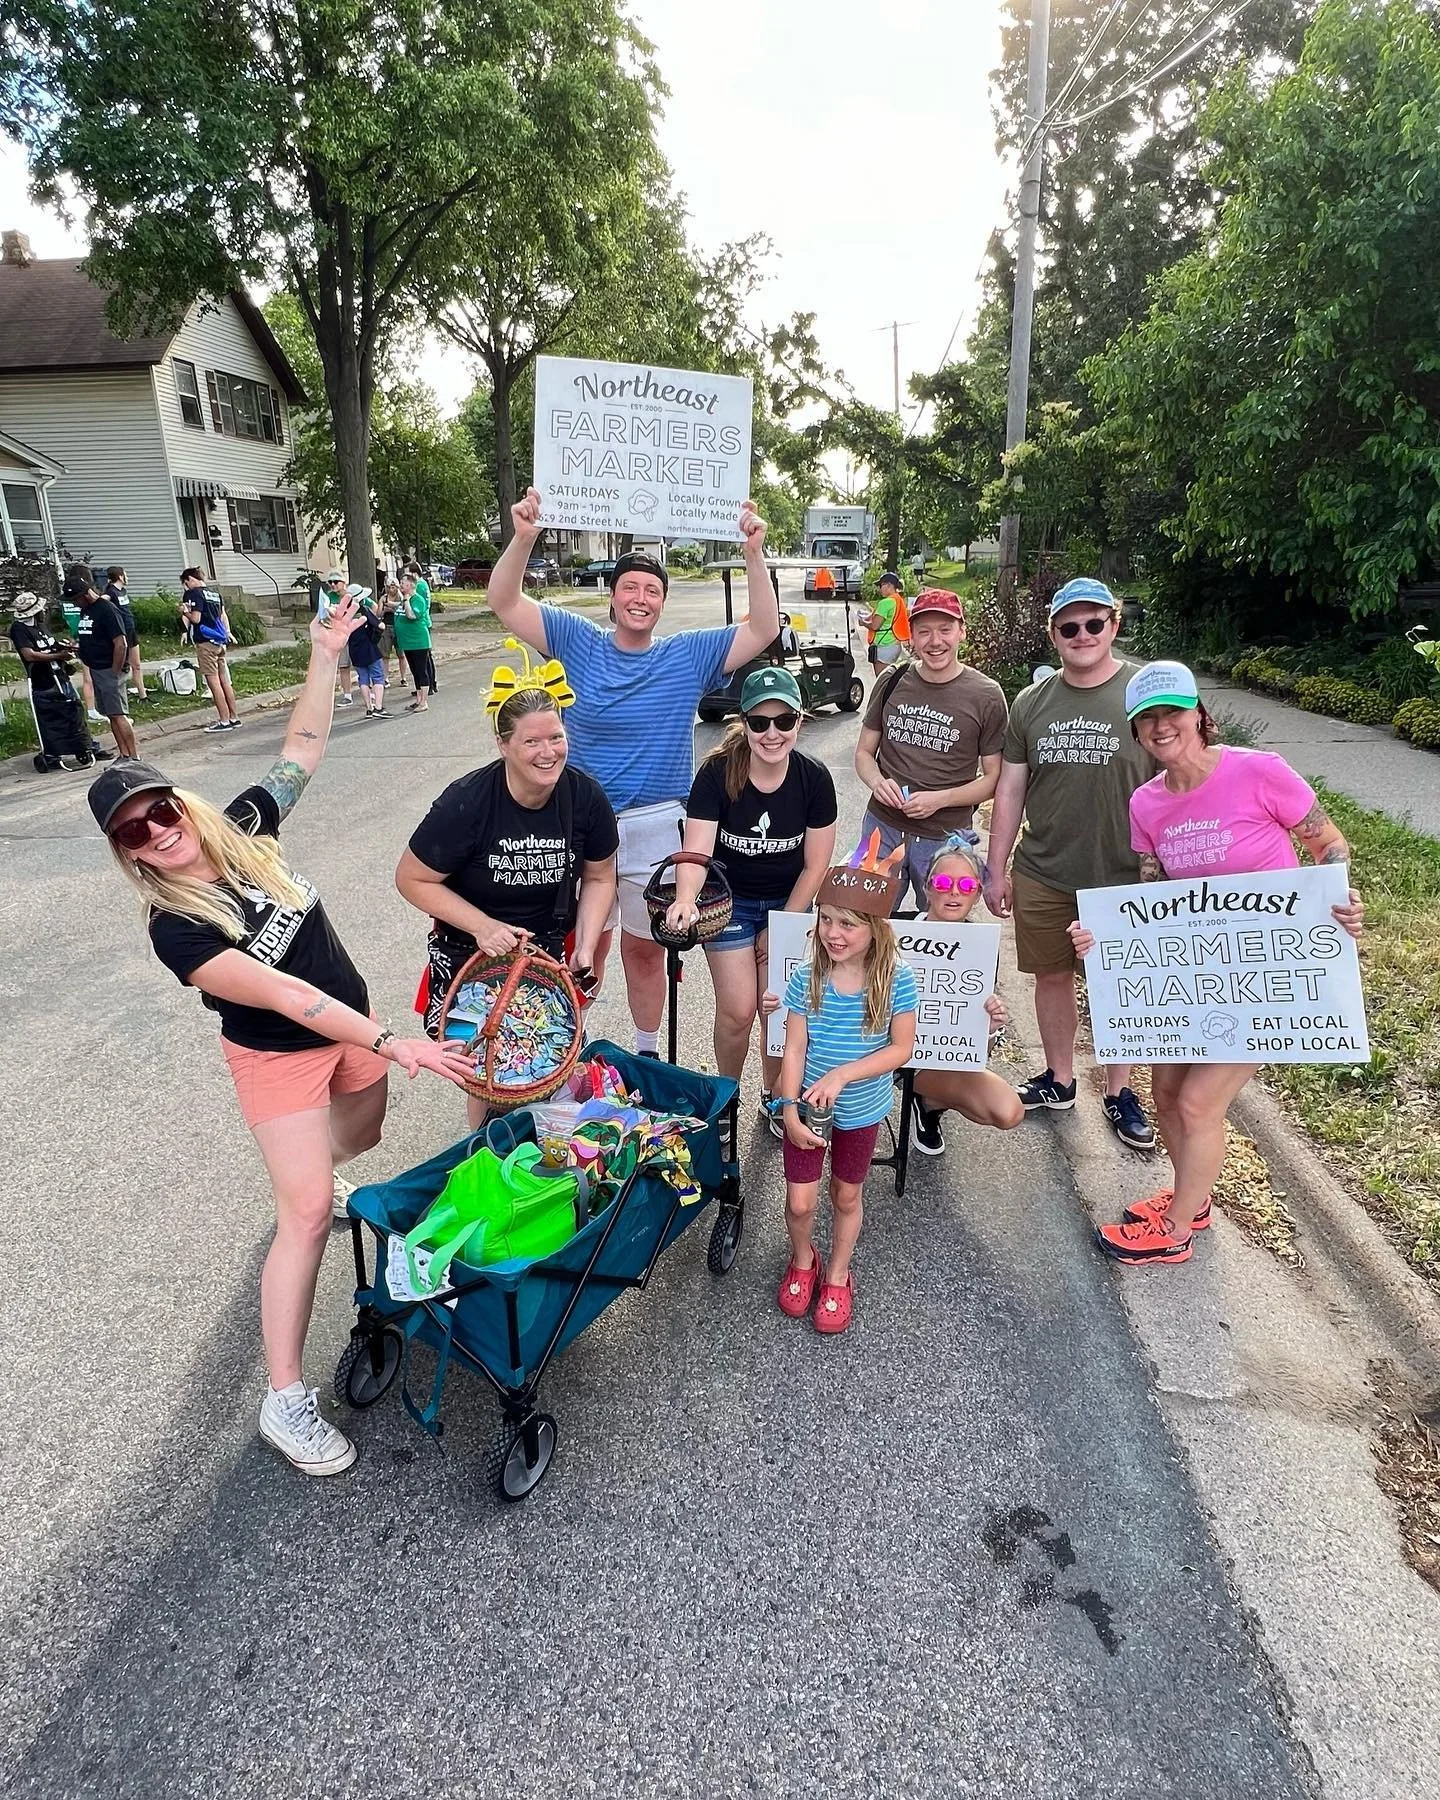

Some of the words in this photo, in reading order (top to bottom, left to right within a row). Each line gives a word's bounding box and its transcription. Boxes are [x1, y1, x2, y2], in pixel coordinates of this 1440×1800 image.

[573, 370, 720, 415] Northeast
[645, 405, 663, 413] 2000
[551, 409, 742, 455] FARMERS
[561, 447, 729, 488] MARKET
[549, 484, 620, 500] SATURDAYS
[668, 492, 705, 507] Locally
[708, 495, 741, 508] Grown
[557, 500, 579, 511] 9am
[590, 503, 610, 513] 1pm
[670, 507, 707, 520] Locally
[710, 510, 738, 521] Made
[559, 514, 577, 524] 2nd
[580, 515, 612, 527] Street
[615, 518, 629, 528] NE
[667, 524, 740, 538] northeastmarket.org
[897, 703, 954, 726] Northeast
[886, 714, 960, 742] FARMERS
[1048, 715, 1112, 735] Northeast
[887, 728, 953, 753] MARKET
[1037, 735, 1120, 751] FARMERS
[1038, 749, 1113, 765] MARKET
[1164, 817, 1221, 840] Northeast
[1158, 829, 1234, 857] FARMERS
[493, 867, 566, 886] MARKE
[1119, 881, 1301, 929] Northeast
[1206, 918, 1228, 927] 2000
[1100, 924, 1342, 971] FARMERS
[1117, 968, 1326, 1008] MARKET
[1108, 1015, 1190, 1029] SATURDAYS
[1252, 1016, 1283, 1030] EAT
[1290, 1014, 1349, 1030] LOCAL
[932, 1035, 976, 1048] LOCAL
[1119, 1033, 1145, 1043] 9am
[1157, 1033, 1181, 1044] 1pm
[1246, 1037, 1293, 1051] SHOP
[1301, 1036, 1361, 1051] LOCAL
[938, 1051, 981, 1063] LOCAL
[1099, 1047, 1118, 1058] 629
[1121, 1046, 1142, 1057] 2nd
[1145, 1046, 1187, 1057] STREET
[1192, 1046, 1209, 1057] NE
